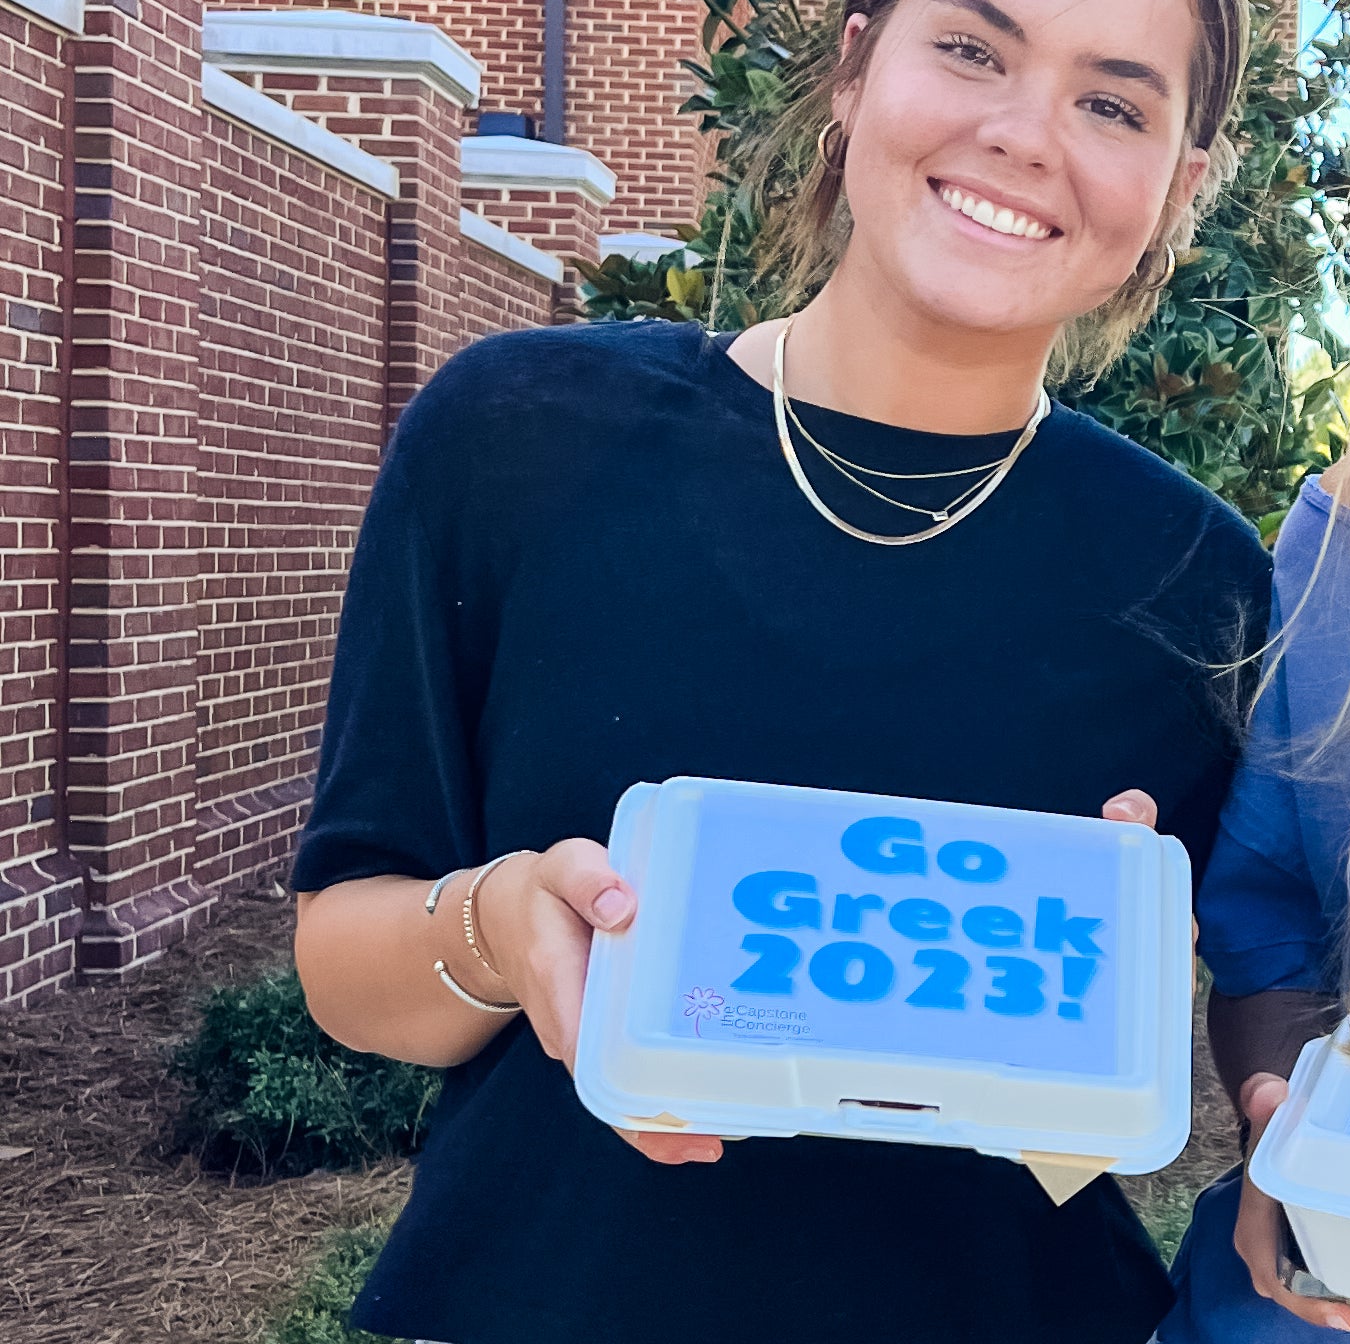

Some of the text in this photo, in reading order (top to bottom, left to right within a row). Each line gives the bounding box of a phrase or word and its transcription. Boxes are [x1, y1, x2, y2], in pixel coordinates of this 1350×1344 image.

[839, 815, 1009, 884] Go
[731, 870, 1105, 956] Greek
[729, 933, 1100, 1023] 2023!
[733, 1018, 811, 1035] Concierge
